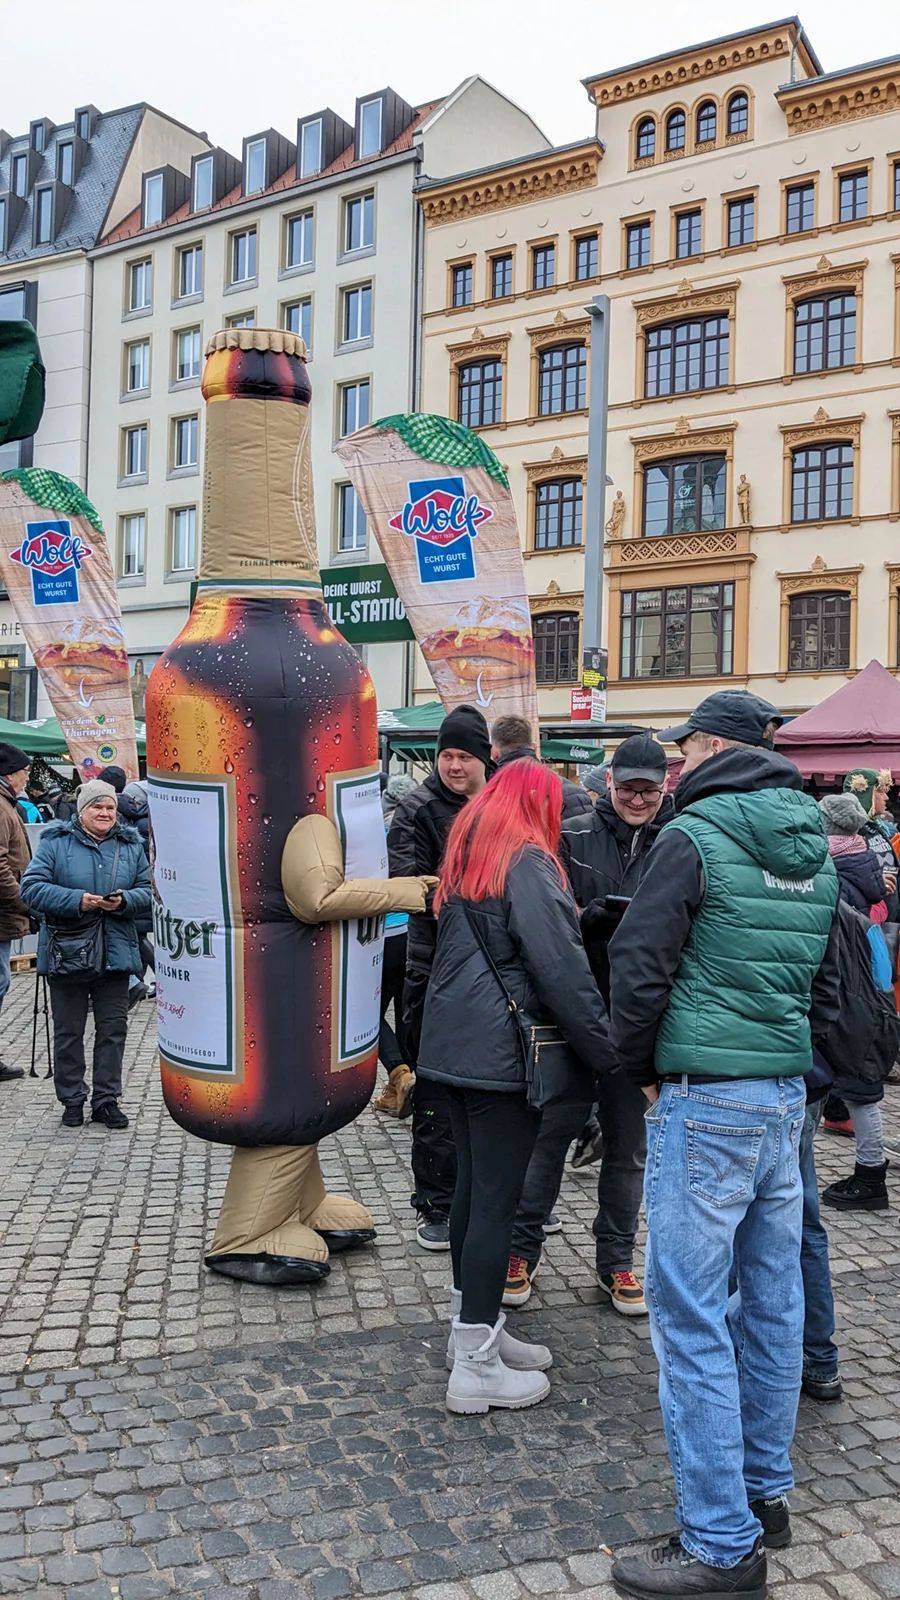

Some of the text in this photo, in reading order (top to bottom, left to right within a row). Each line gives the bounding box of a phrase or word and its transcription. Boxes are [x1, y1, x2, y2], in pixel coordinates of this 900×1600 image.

[402, 495, 483, 537] Wolf
[21, 537, 85, 570] Wolf
[424, 552, 467, 564] ECHT GUTE
[433, 563, 460, 573] WURST
[55, 580, 72, 588] GUTE
[324, 580, 382, 598] DEINE WURST
[325, 597, 409, 625] LL-STATIO
[1, 622, 20, 636] RIE
[76, 716, 92, 725] dem
[64, 727, 117, 738] Thüringens
[171, 795, 201, 805] KROSTITZ
[160, 868, 176, 881] 1534
[158, 961, 190, 982] PILSNER
[167, 1040, 216, 1058] REINHEITSGEBOT
